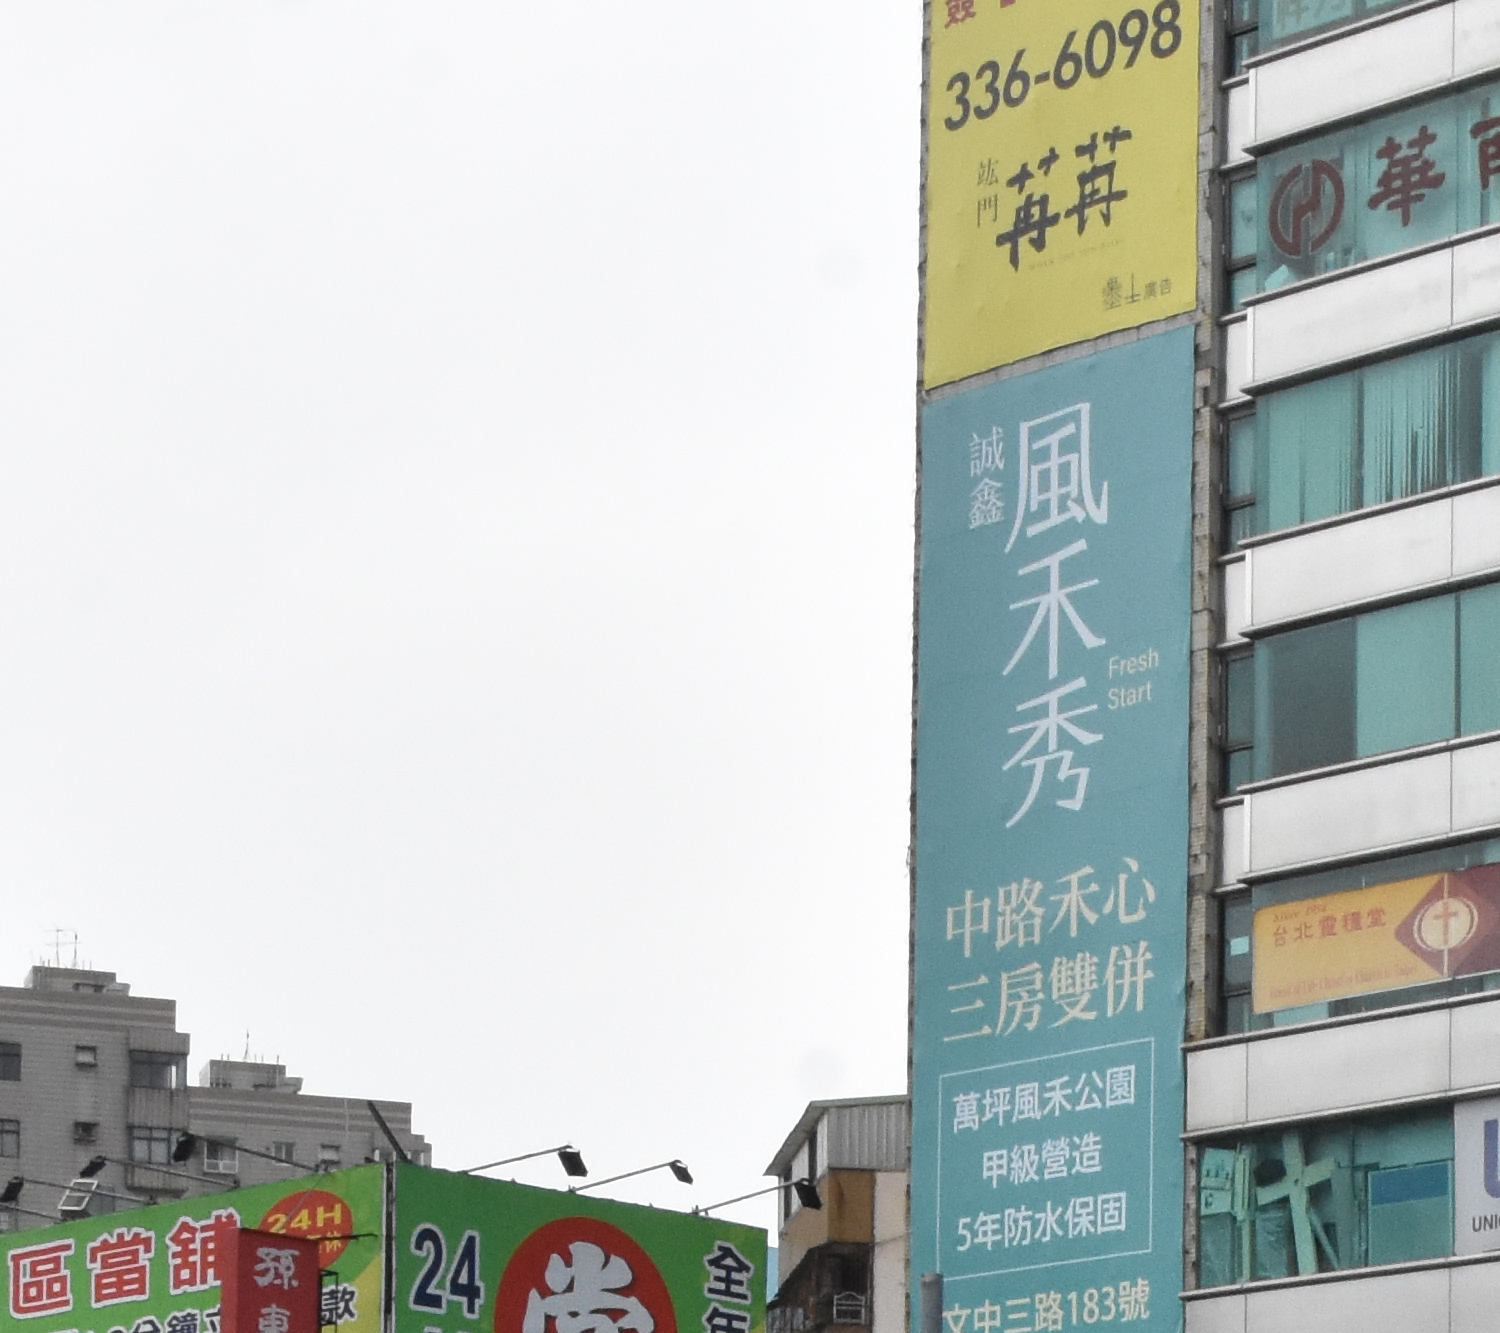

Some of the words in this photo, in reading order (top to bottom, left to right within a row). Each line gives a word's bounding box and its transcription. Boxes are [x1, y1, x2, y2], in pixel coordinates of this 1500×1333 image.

[944, 0, 1182, 131] 336-6098
[1002, 402, 1109, 828] 風禾秀
[1109, 647, 1159, 680] Fresh
[1109, 680, 1154, 710] Start
[945, 858, 1155, 959] 中路禾心
[1273, 907, 1387, 947] 台北靈糧堂
[943, 942, 1155, 1043] 三房雙併
[953, 1064, 1137, 1136] 萬坪風禾公園
[981, 1132, 1104, 1190] 甲級營造
[266, 1203, 343, 1234] 24H
[956, 1191, 1128, 1252] 5年防水保固
[410, 1222, 484, 1319] 24
